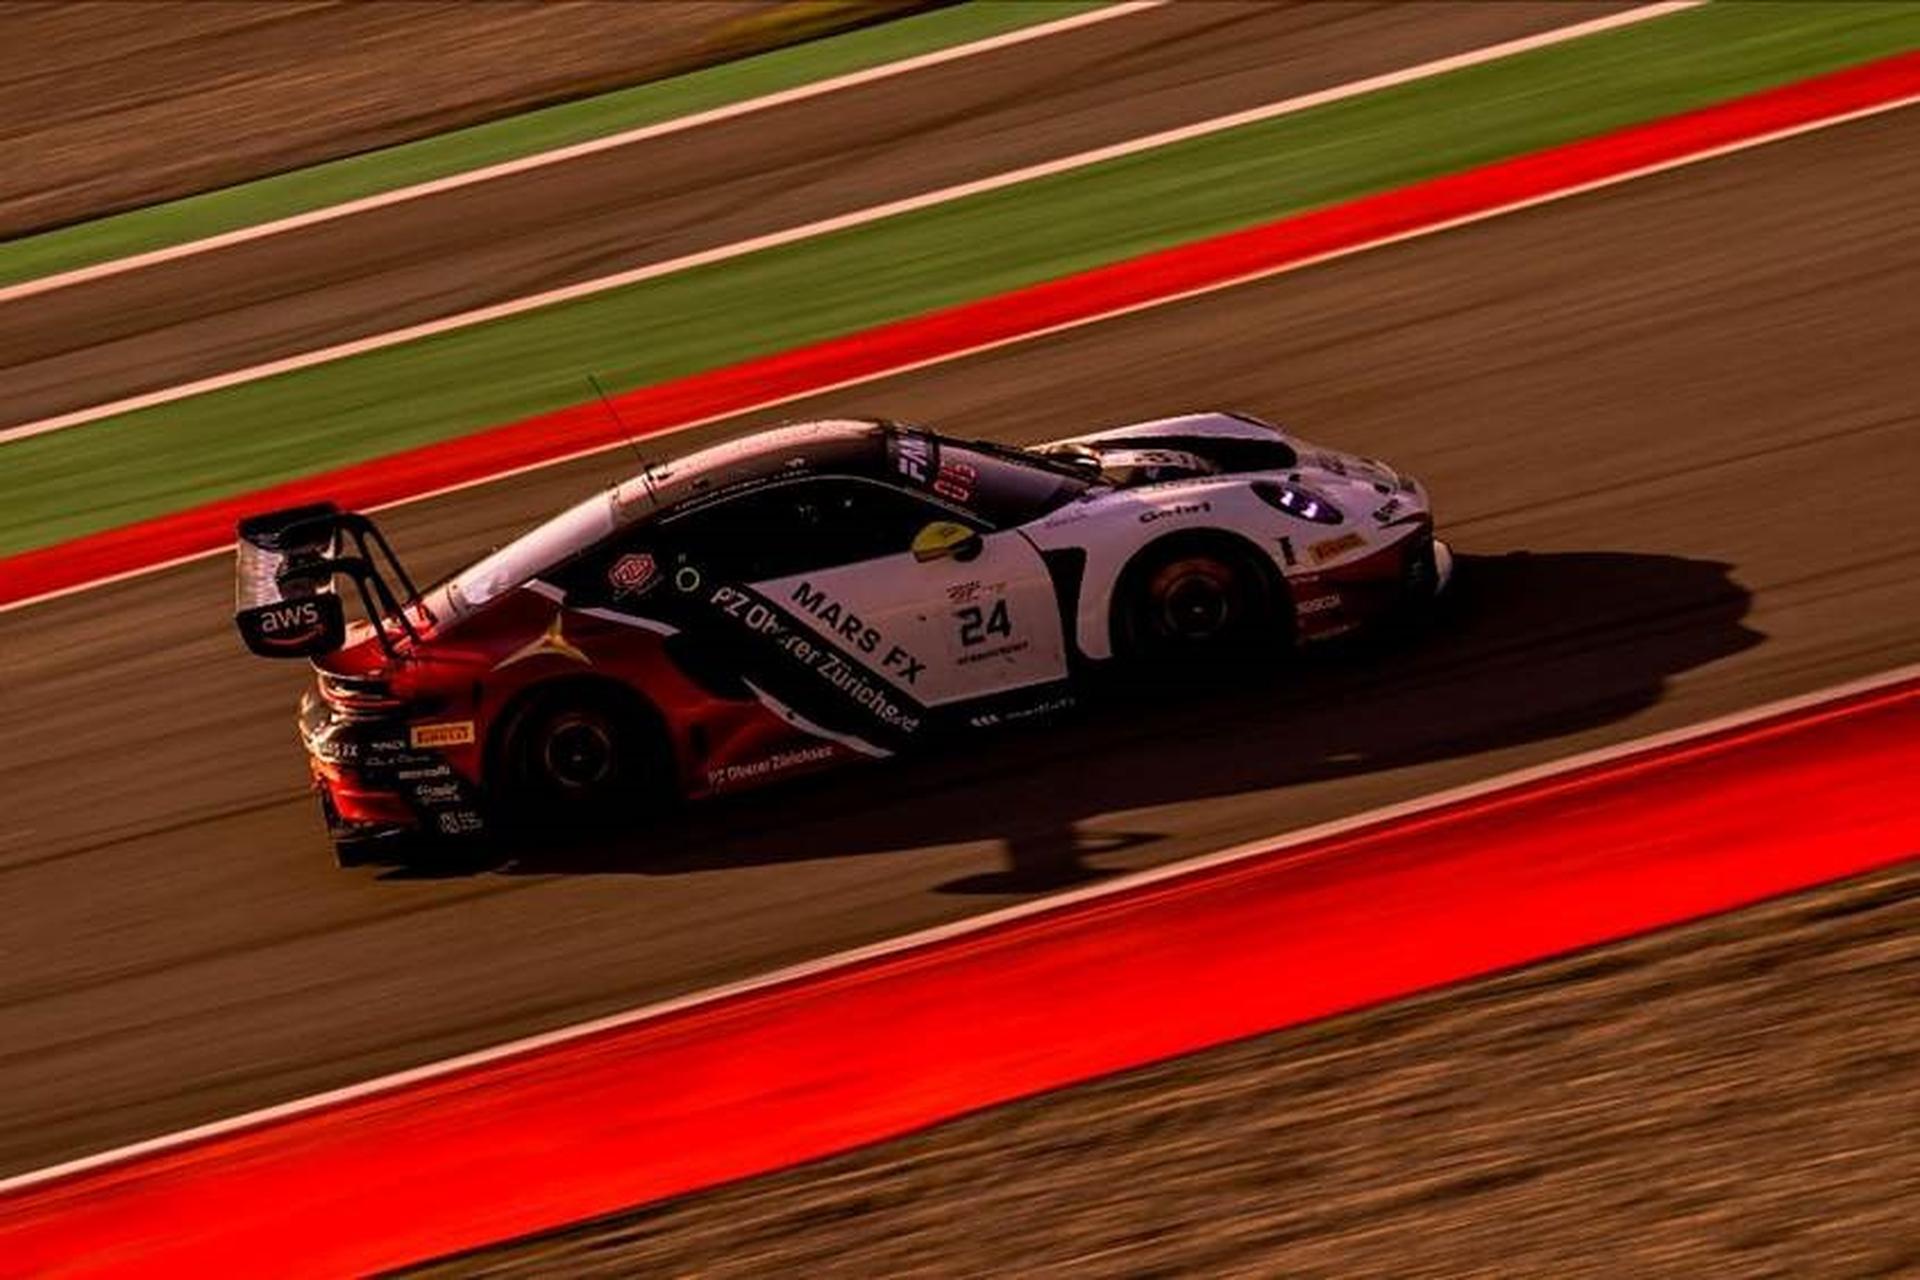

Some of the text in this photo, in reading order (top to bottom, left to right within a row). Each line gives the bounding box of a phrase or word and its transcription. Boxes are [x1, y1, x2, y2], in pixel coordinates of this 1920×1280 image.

[260, 602, 320, 633] aws
[710, 585, 750, 618] PZ
[745, 604, 823, 665] Obrer
[791, 583, 881, 653] MARS
[882, 646, 926, 685] FX
[957, 598, 1012, 647] 24
